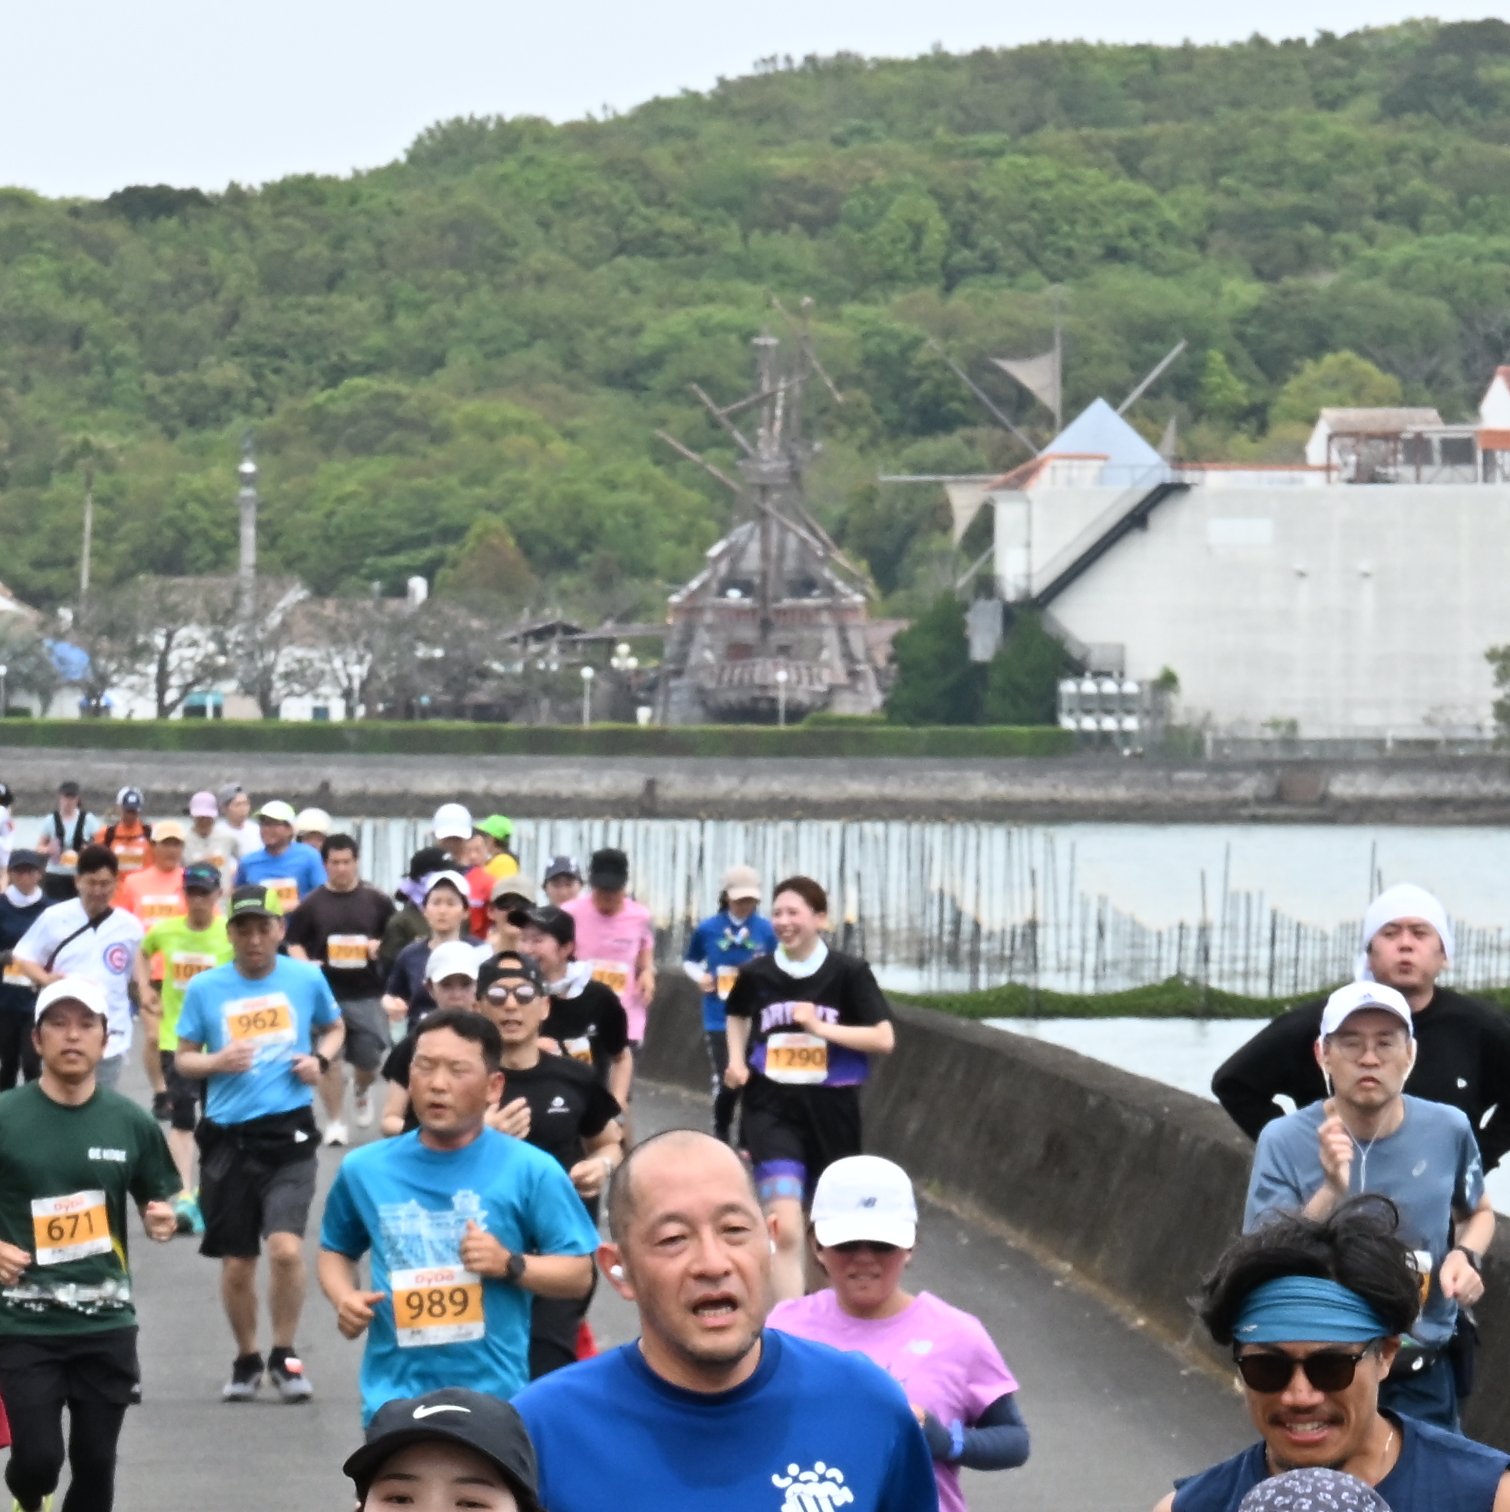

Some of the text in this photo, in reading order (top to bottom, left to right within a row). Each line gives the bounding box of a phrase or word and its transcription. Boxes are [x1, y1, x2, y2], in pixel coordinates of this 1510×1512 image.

[238, 1010, 278, 1033] 962
[772, 1048, 825, 1067] 1290
[47, 1211, 93, 1241] 671
[406, 1287, 469, 1320] 989
